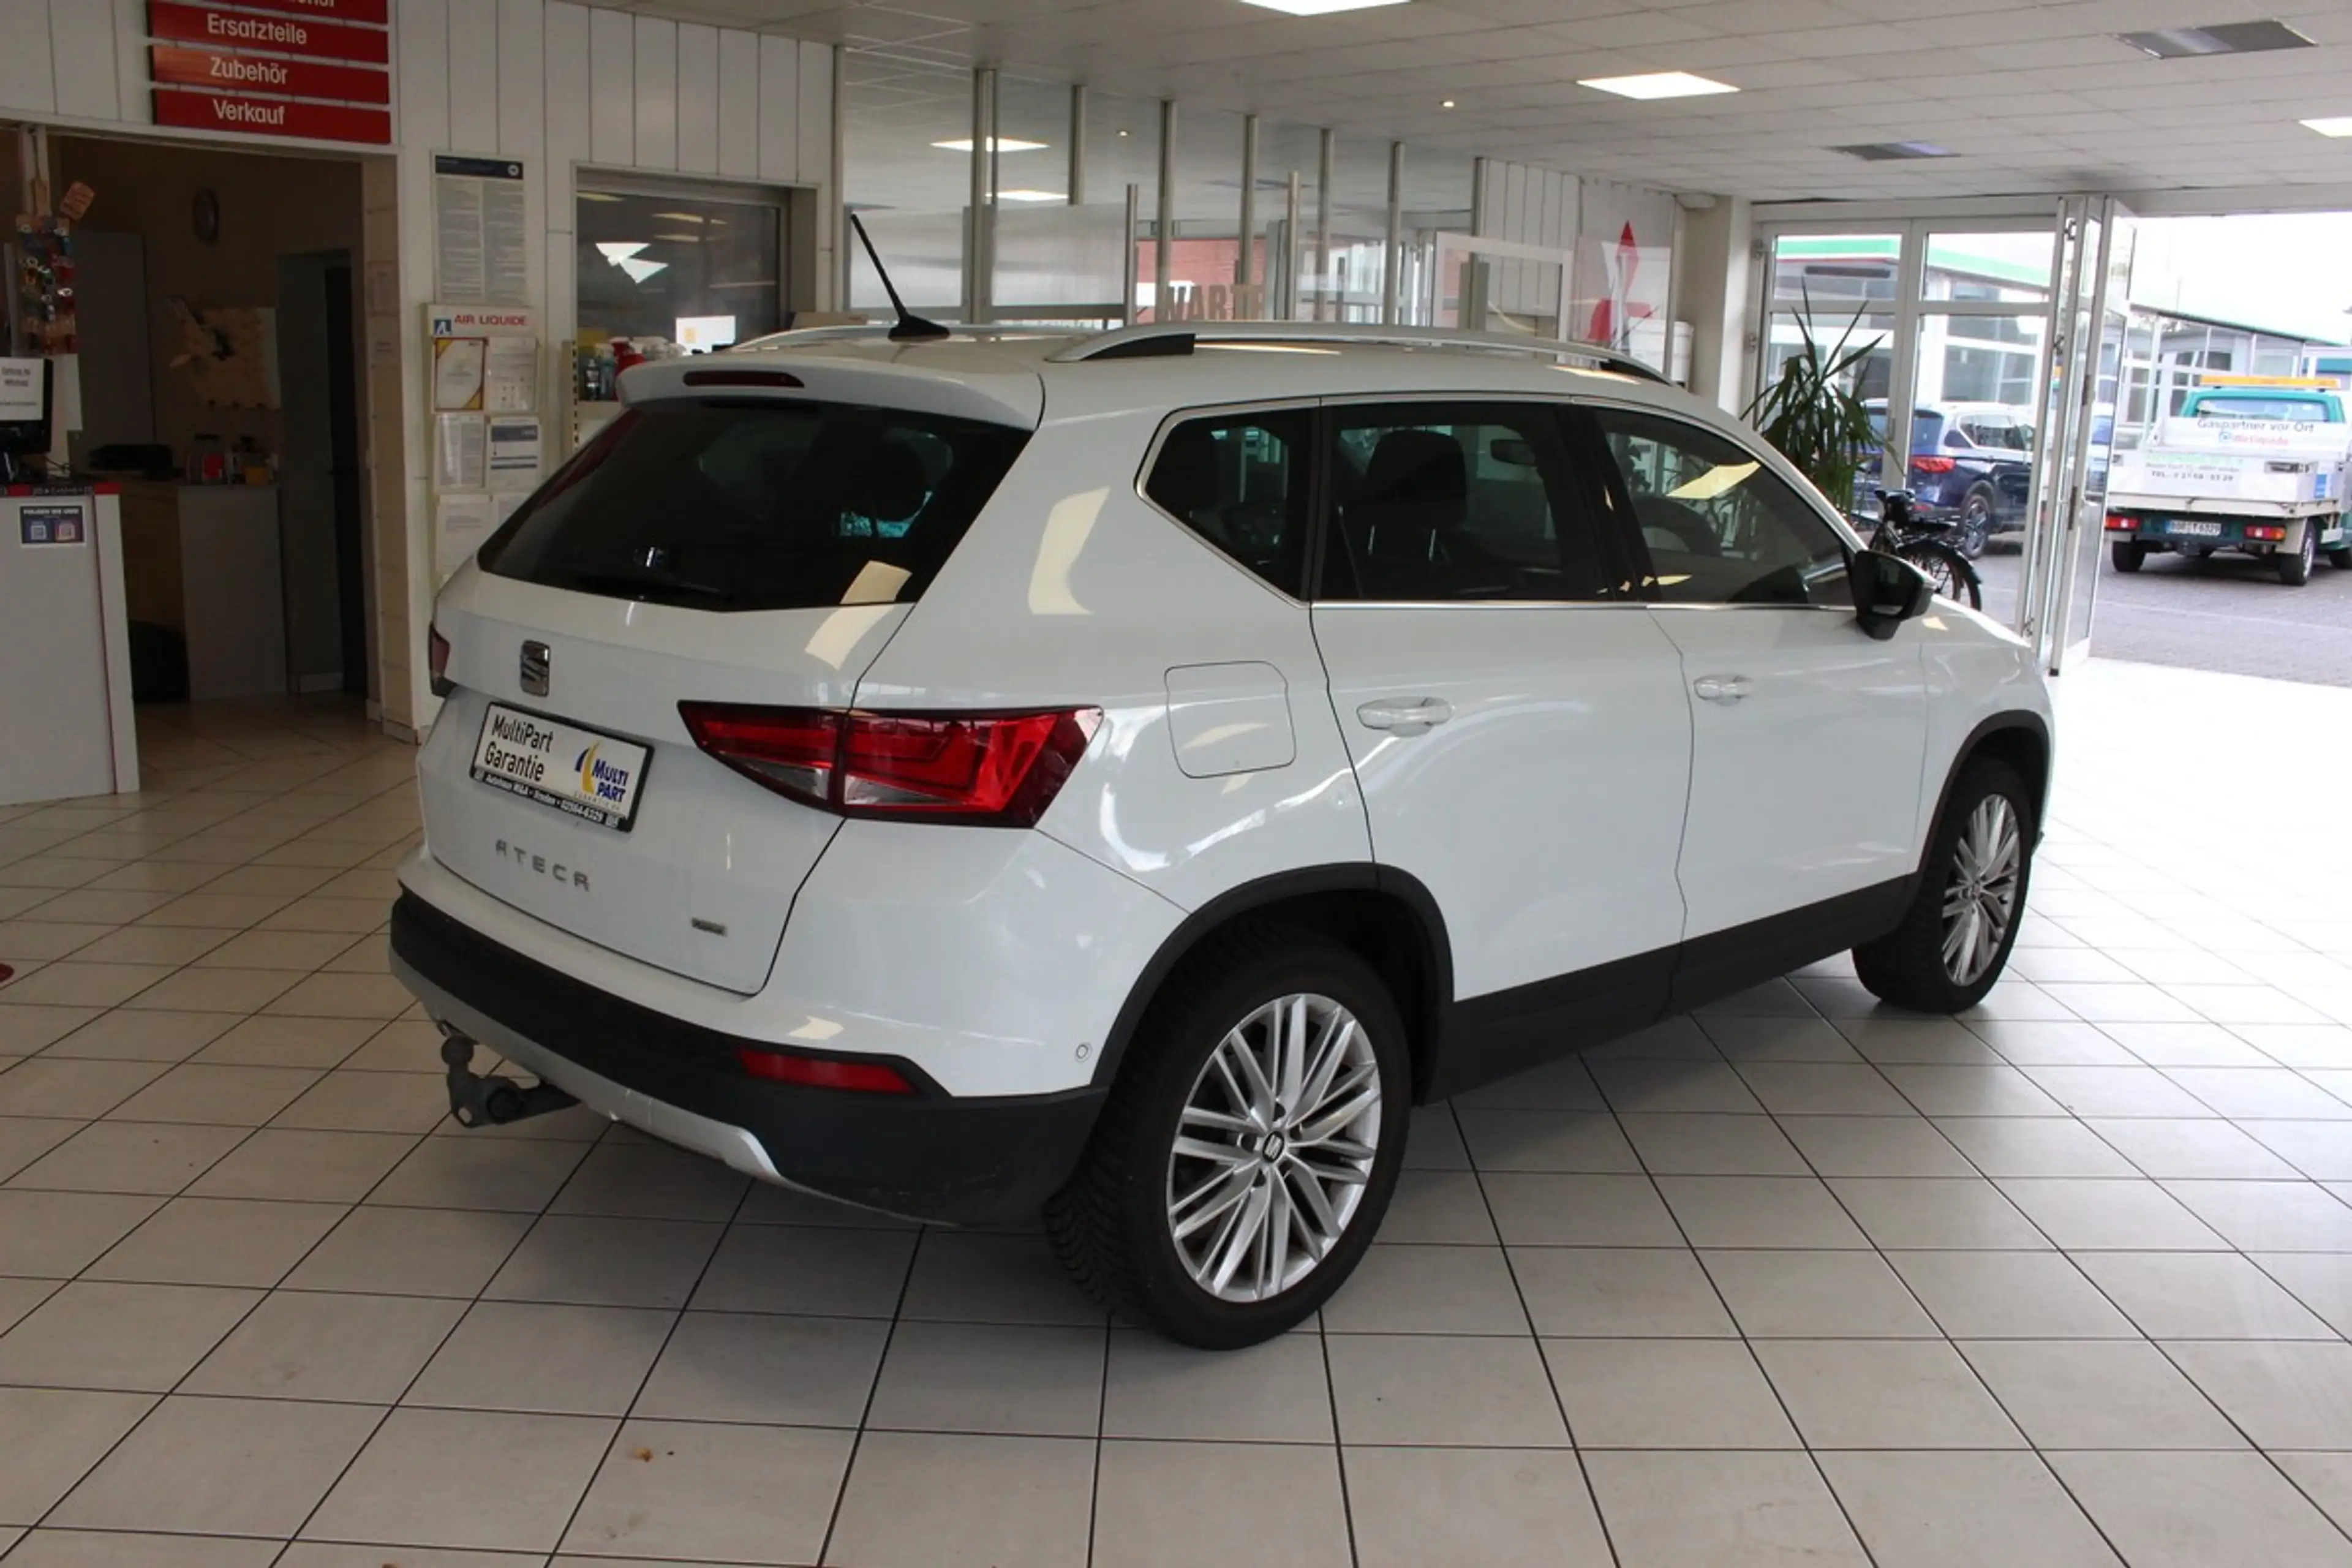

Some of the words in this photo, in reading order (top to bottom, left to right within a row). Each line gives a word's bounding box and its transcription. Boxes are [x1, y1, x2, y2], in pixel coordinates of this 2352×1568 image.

[206, 13, 307, 45] Ersatzteile
[209, 56, 288, 85] Zubehör
[213, 98, 285, 126] Verkauf
[454, 314, 475, 325] AIR
[479, 315, 527, 326] LIQUIDE
[2197, 418, 2266, 431] Gaspartner
[2269, 421, 2290, 431] vor
[2293, 420, 2314, 433] Ort
[491, 715, 554, 753] MultiPart
[484, 741, 544, 782] Garantie
[592, 758, 630, 786] MULTI
[596, 782, 626, 802] PART
[495, 839, 590, 892] ATECA
